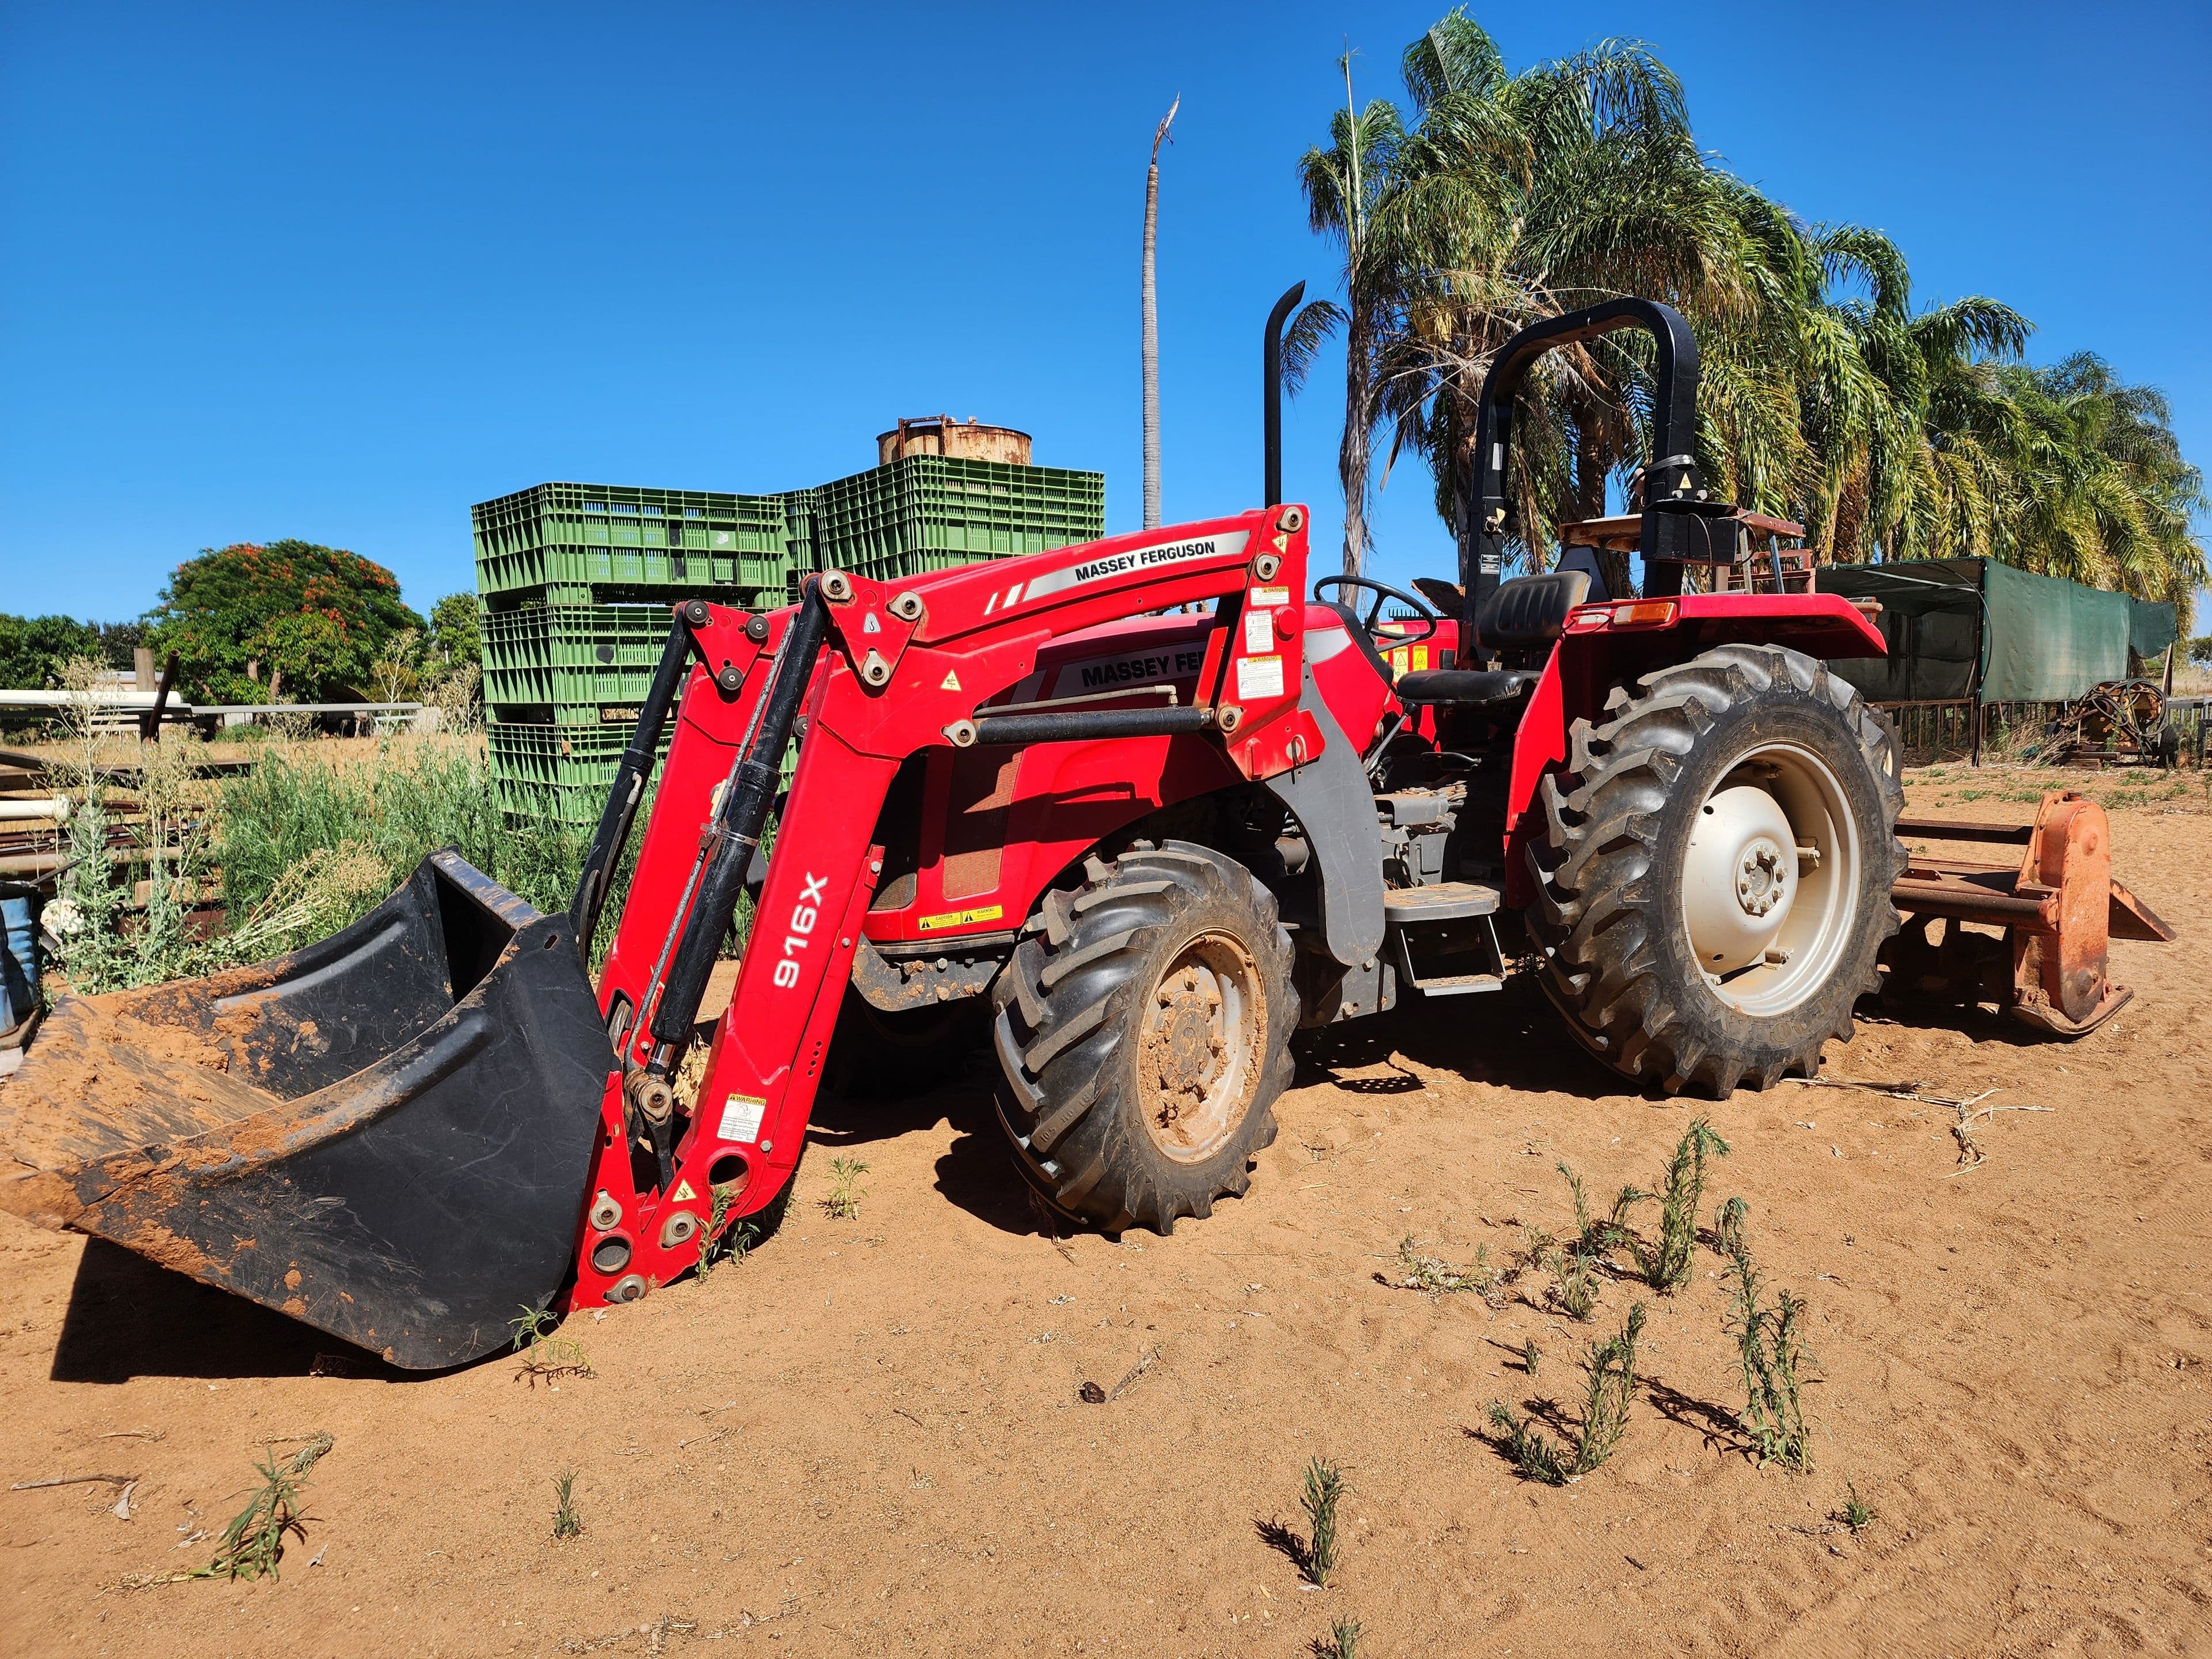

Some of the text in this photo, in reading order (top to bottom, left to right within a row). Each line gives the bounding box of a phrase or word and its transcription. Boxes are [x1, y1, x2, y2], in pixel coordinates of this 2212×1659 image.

[1075, 541, 1215, 581] MASSEY FERGUSON
[1081, 656, 1169, 687] MASSEY
[773, 871, 828, 988] 916X
[737, 1096, 766, 1105] WARNING
